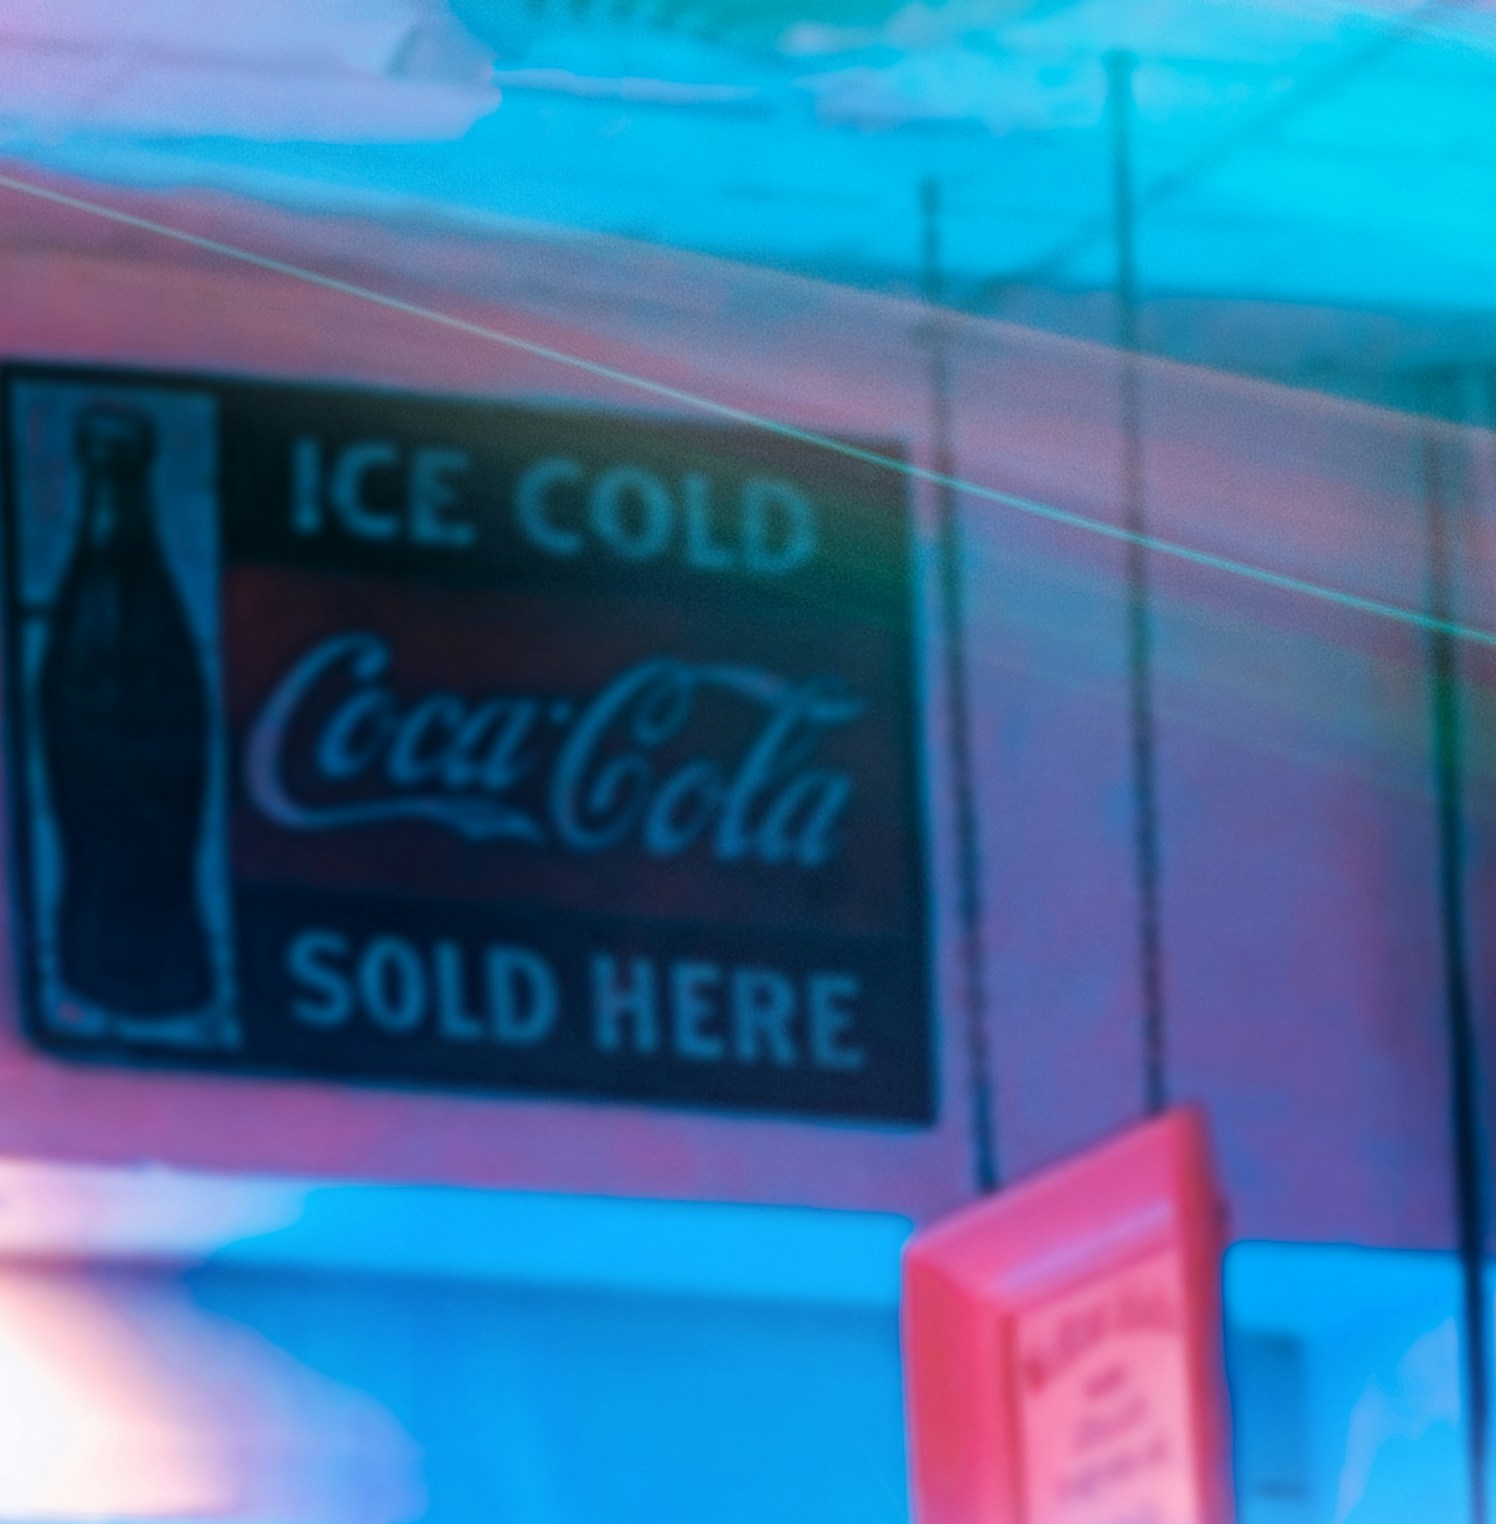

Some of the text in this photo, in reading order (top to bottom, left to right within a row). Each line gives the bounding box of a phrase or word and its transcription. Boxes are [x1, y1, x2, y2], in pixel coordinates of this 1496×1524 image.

[289, 436, 819, 575] ICE COLD
[245, 631, 865, 868] Coca-Cola
[285, 929, 867, 1070] SOLD HERE
